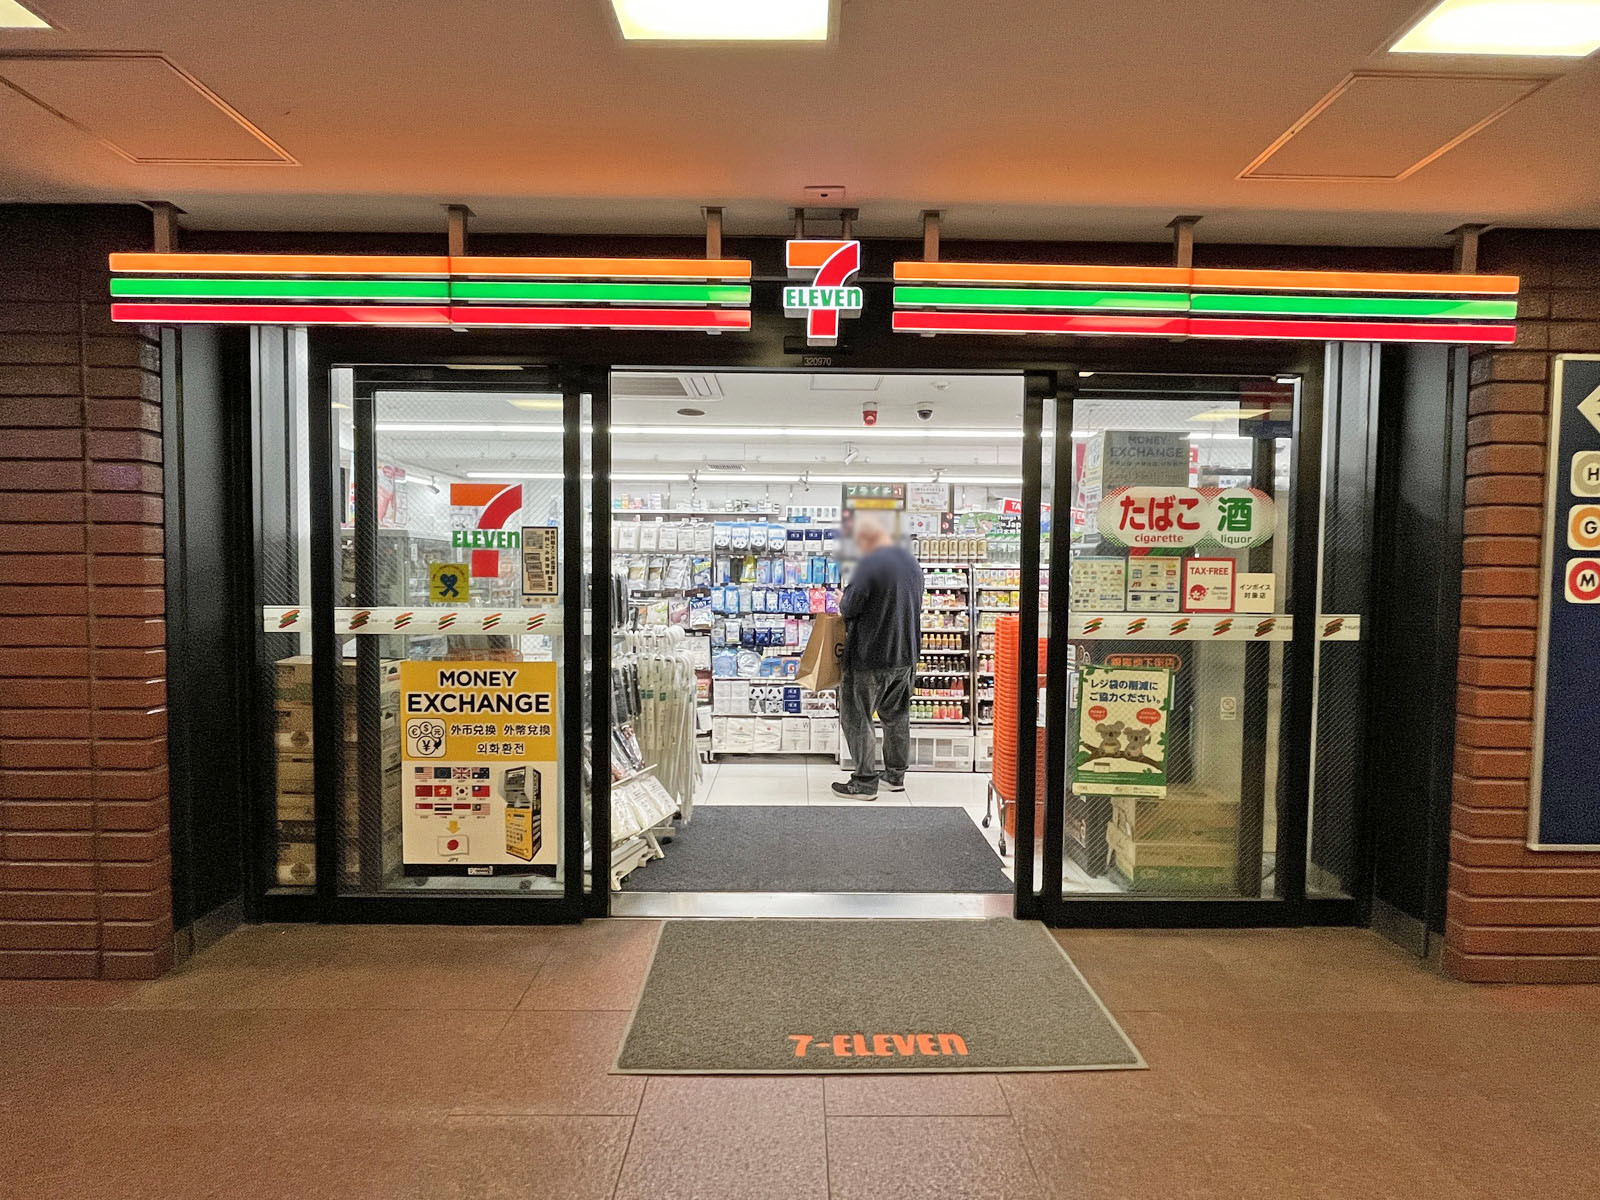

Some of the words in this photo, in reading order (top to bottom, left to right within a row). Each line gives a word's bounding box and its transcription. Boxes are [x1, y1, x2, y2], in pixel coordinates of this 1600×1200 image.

[1127, 435, 1168, 445] MONEY
[1110, 446, 1184, 458] EXCHANGE
[1587, 467, 1599, 481] H
[1119, 495, 1200, 532] たばこ
[1217, 496, 1253, 532] 酒
[1584, 520, 1598, 534] G
[1134, 533, 1184, 544] cigarette
[1220, 534, 1253, 544] liquor
[1190, 566, 1229, 576] TAX-FREE
[1579, 573, 1596, 587] M
[439, 671, 517, 687] MONEY
[407, 693, 550, 713] EXCHANGE
